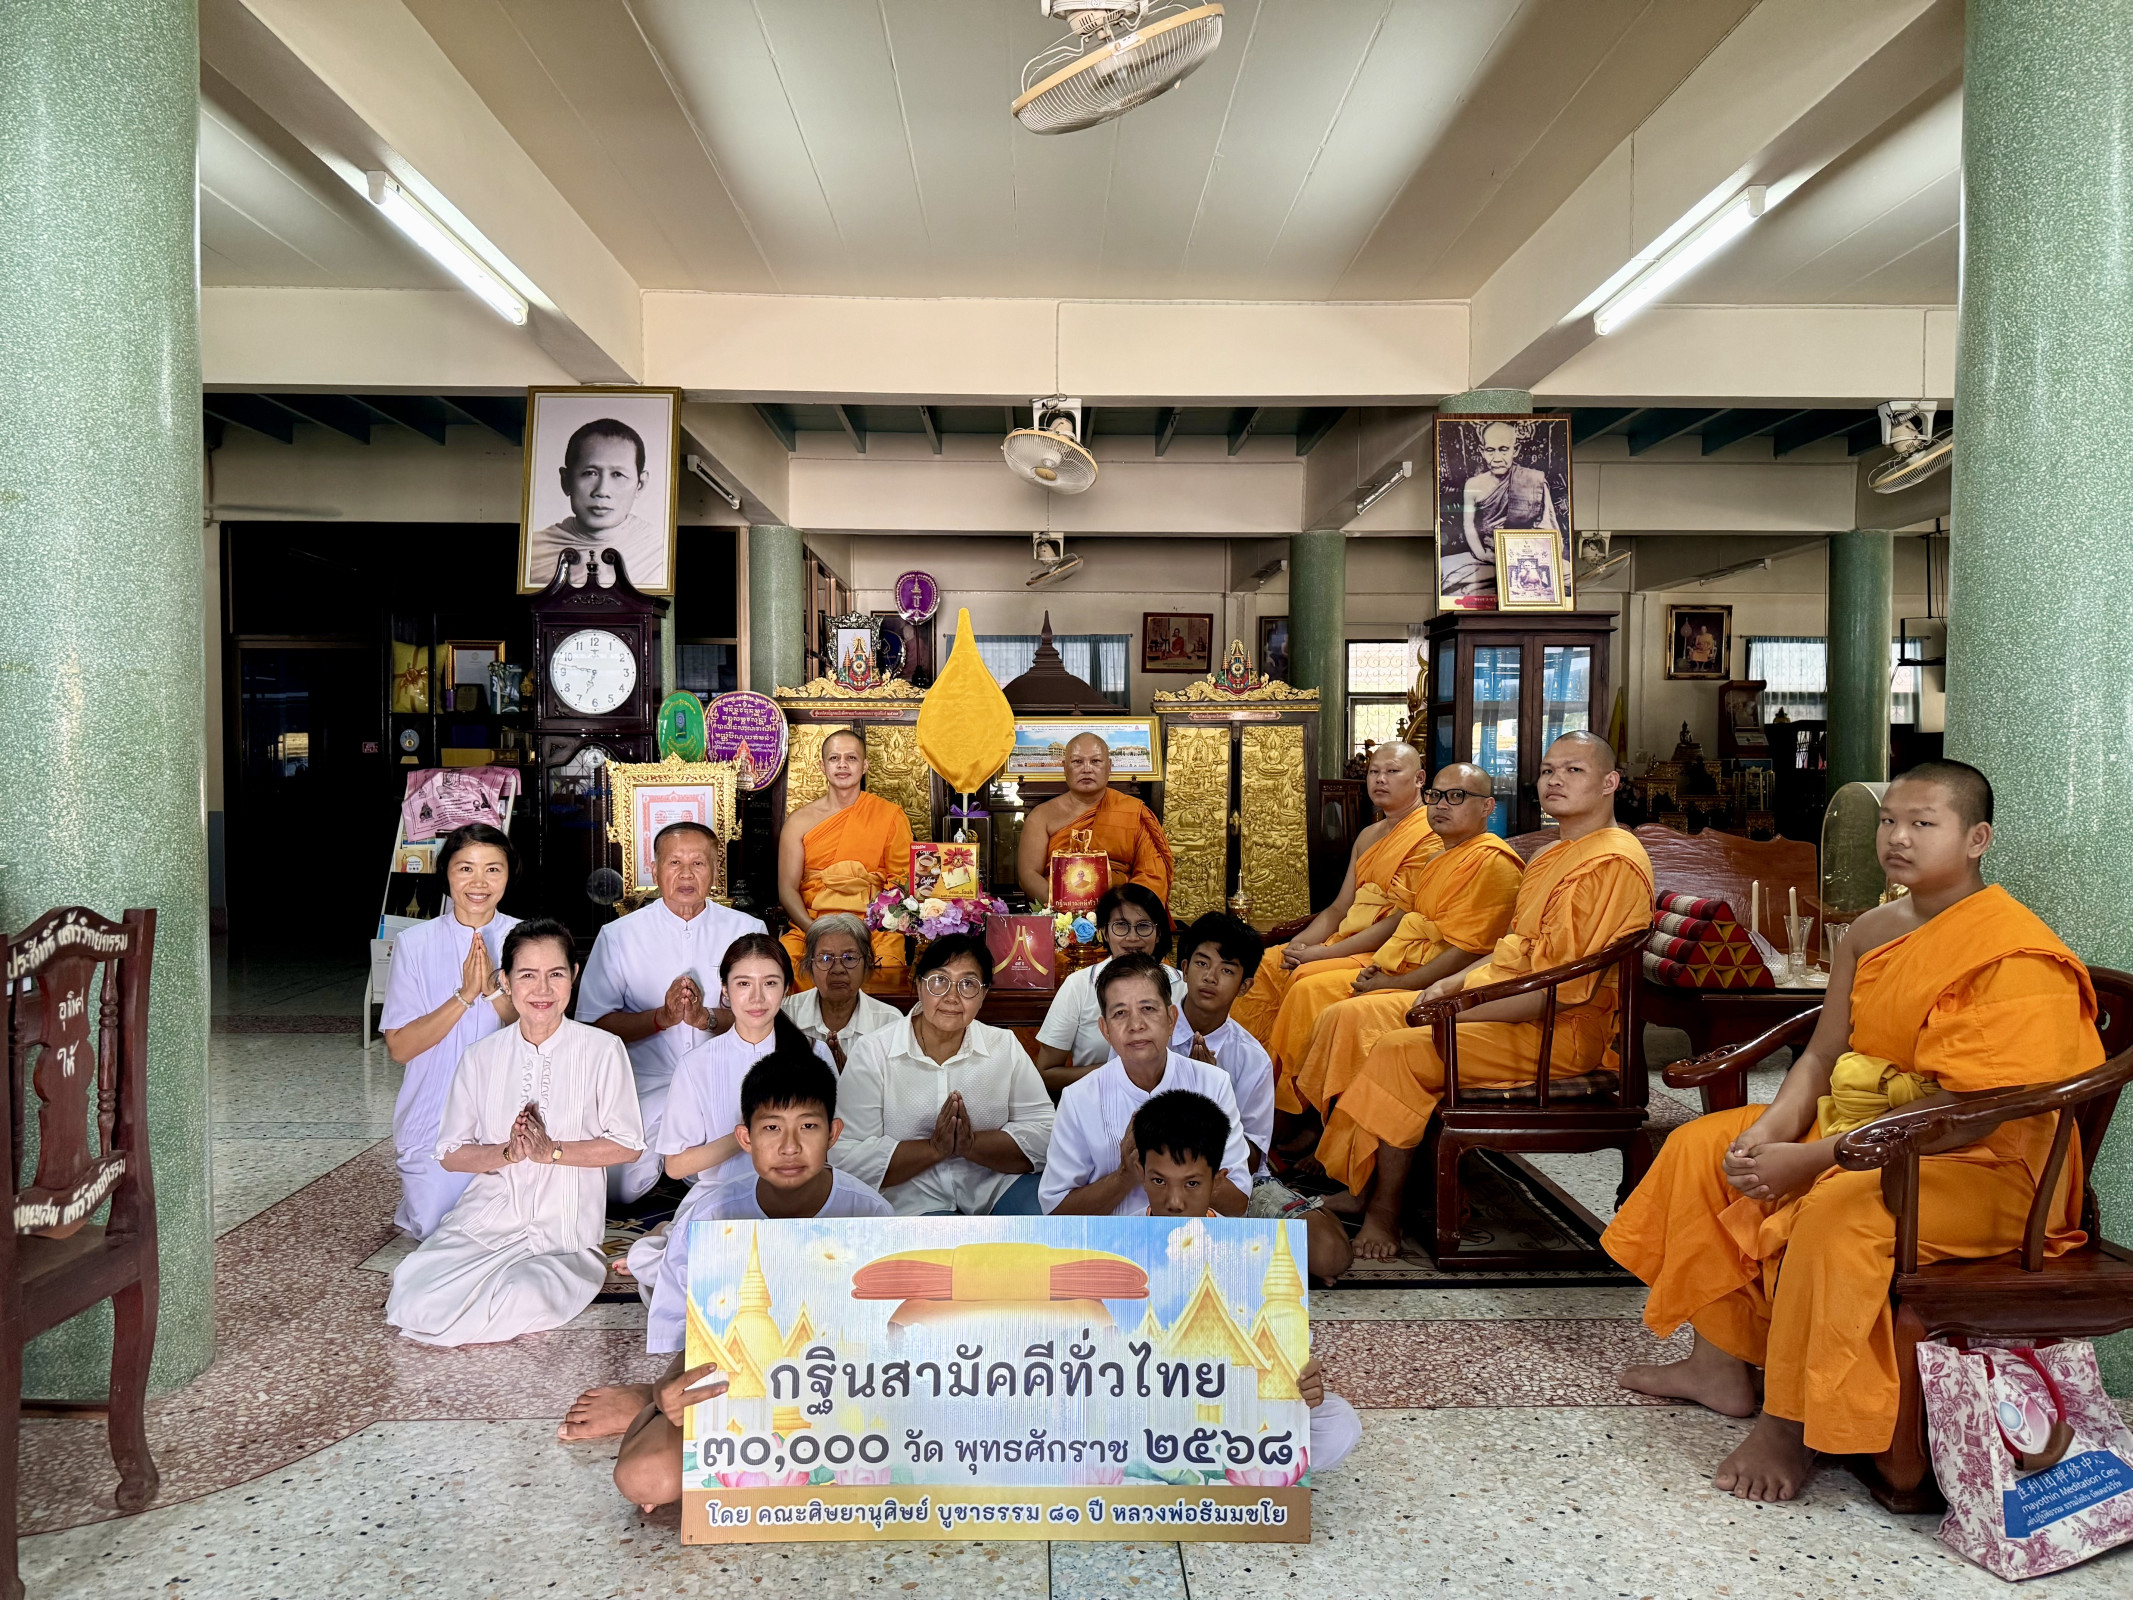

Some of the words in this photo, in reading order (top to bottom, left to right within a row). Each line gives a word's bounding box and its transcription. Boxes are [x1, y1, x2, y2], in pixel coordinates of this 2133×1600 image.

[576, 642, 583, 651] 11
[590, 637, 599, 647] 12
[609, 642, 612, 651] 1
[564, 652, 573, 661] 10
[619, 653, 625, 662] 2
[560, 667, 567, 677] 9
[623, 668, 630, 677] 3
[564, 683, 570, 692] 8
[619, 683, 625, 692] 4
[576, 694, 582, 703] 7
[591, 698, 598, 707] 6
[608, 694, 614, 703] 5
[57, 1040, 79, 1078] ให้
[769, 1329, 1226, 1416] กฐินสามัคคีทั่วไทย
[703, 1433, 890, 1472] ๓๐,๐๐๐
[904, 1428, 943, 1463] วัด
[955, 1428, 1129, 1476] พุทธศักราช
[1144, 1427, 1293, 1465] ๒๕๖๘
[2059, 1473, 2101, 1496] Meditation
[709, 1502, 749, 1524] โดย
[758, 1498, 928, 1529] คณะศิษยานุศิษย์
[938, 1505, 1040, 1528] บูชาธรรม
[1049, 1505, 1080, 1522] ๘๑
[1088, 1498, 1104, 1522] ปี
[1112, 1500, 1287, 1524] หลวงพ่อธัมมชโย
